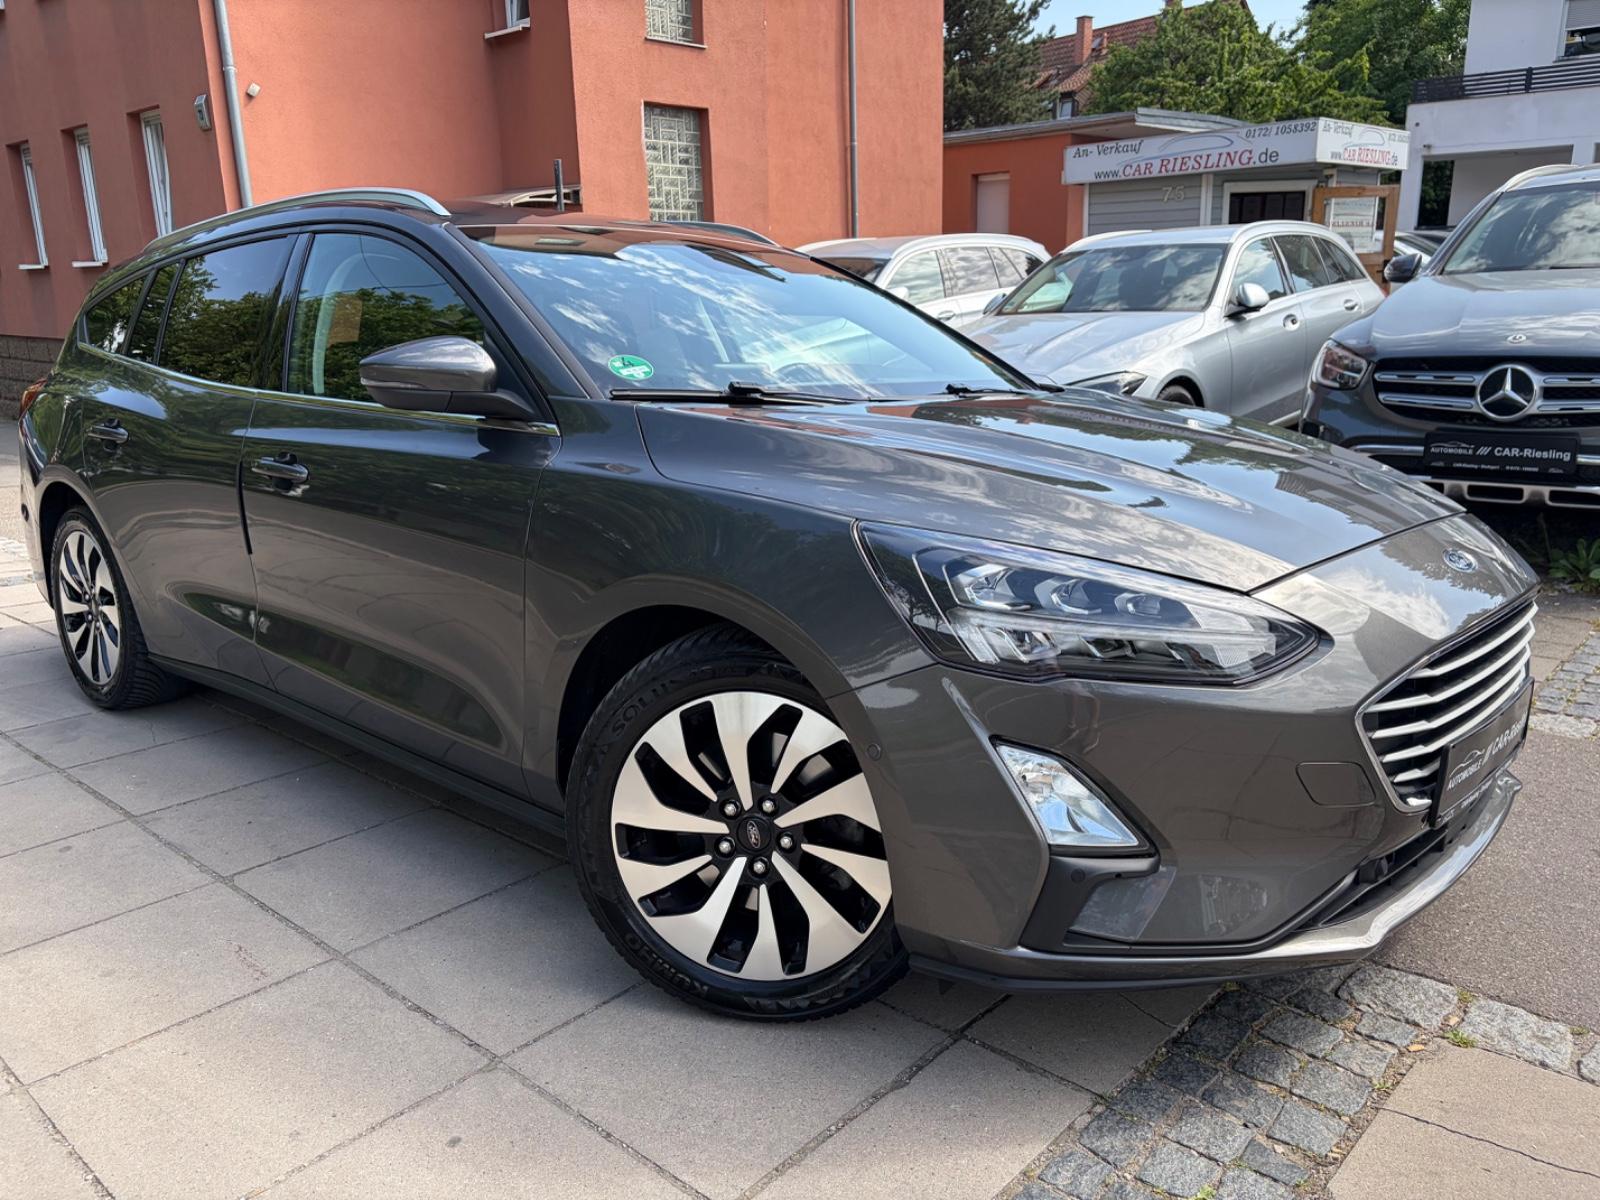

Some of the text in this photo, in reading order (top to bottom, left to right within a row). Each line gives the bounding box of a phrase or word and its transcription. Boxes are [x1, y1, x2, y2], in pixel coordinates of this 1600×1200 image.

[1274, 121, 1317, 136] 1058392
[1073, 140, 1144, 159] An- Verkauf
[1162, 185, 1185, 202] 75
[1494, 446, 1571, 462] CAR-Riesling
